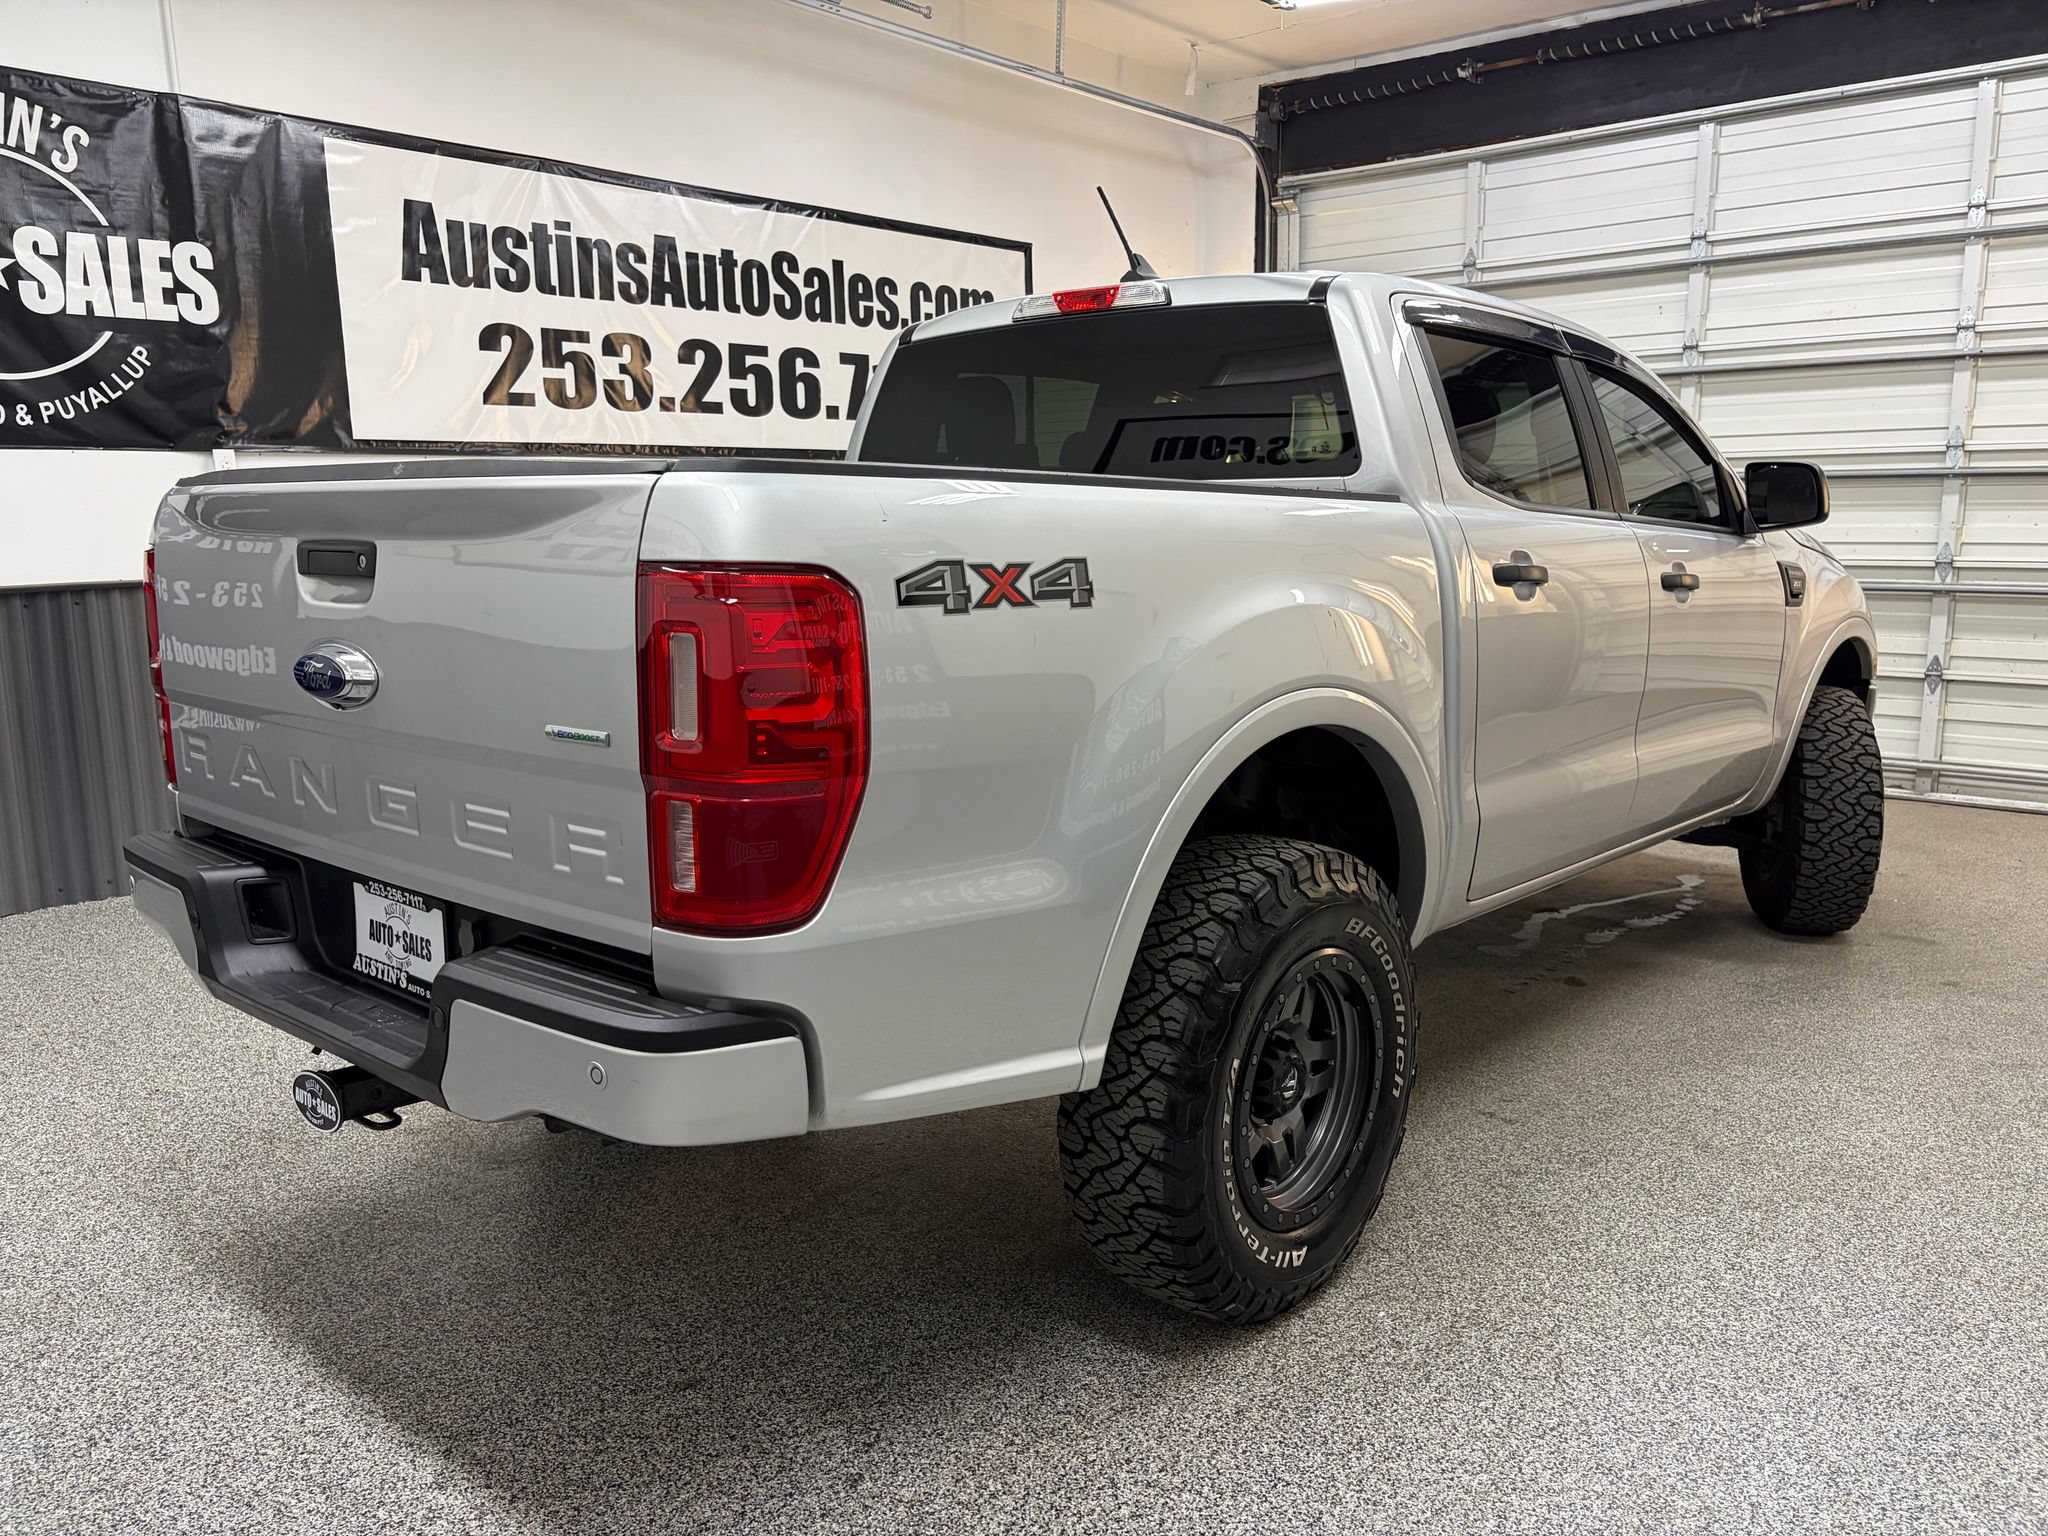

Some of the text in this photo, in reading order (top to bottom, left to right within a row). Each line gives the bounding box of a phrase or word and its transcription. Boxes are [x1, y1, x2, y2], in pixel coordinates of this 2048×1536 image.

[13, 225, 220, 325] SALES
[15, 404, 34, 426] &
[40, 345, 152, 425] PUYALLUP
[478, 322, 878, 421] 253.256.7
[303, 660, 332, 690] Ford
[178, 728, 626, 886] RANGER
[368, 881, 424, 910] 253-256-7117
[384, 902, 412, 926] AUSTIN'S
[369, 919, 393, 948] AUTO
[402, 930, 432, 962] SALES
[353, 953, 407, 989] AUSTIN'S
[408, 983, 425, 997] AUTO
[1343, 916, 1405, 1098] BFGoodrich
[295, 1086, 312, 1108] AUTO
[316, 1098, 337, 1122] SALES
[1223, 1138, 1308, 1270] All-Terrain
